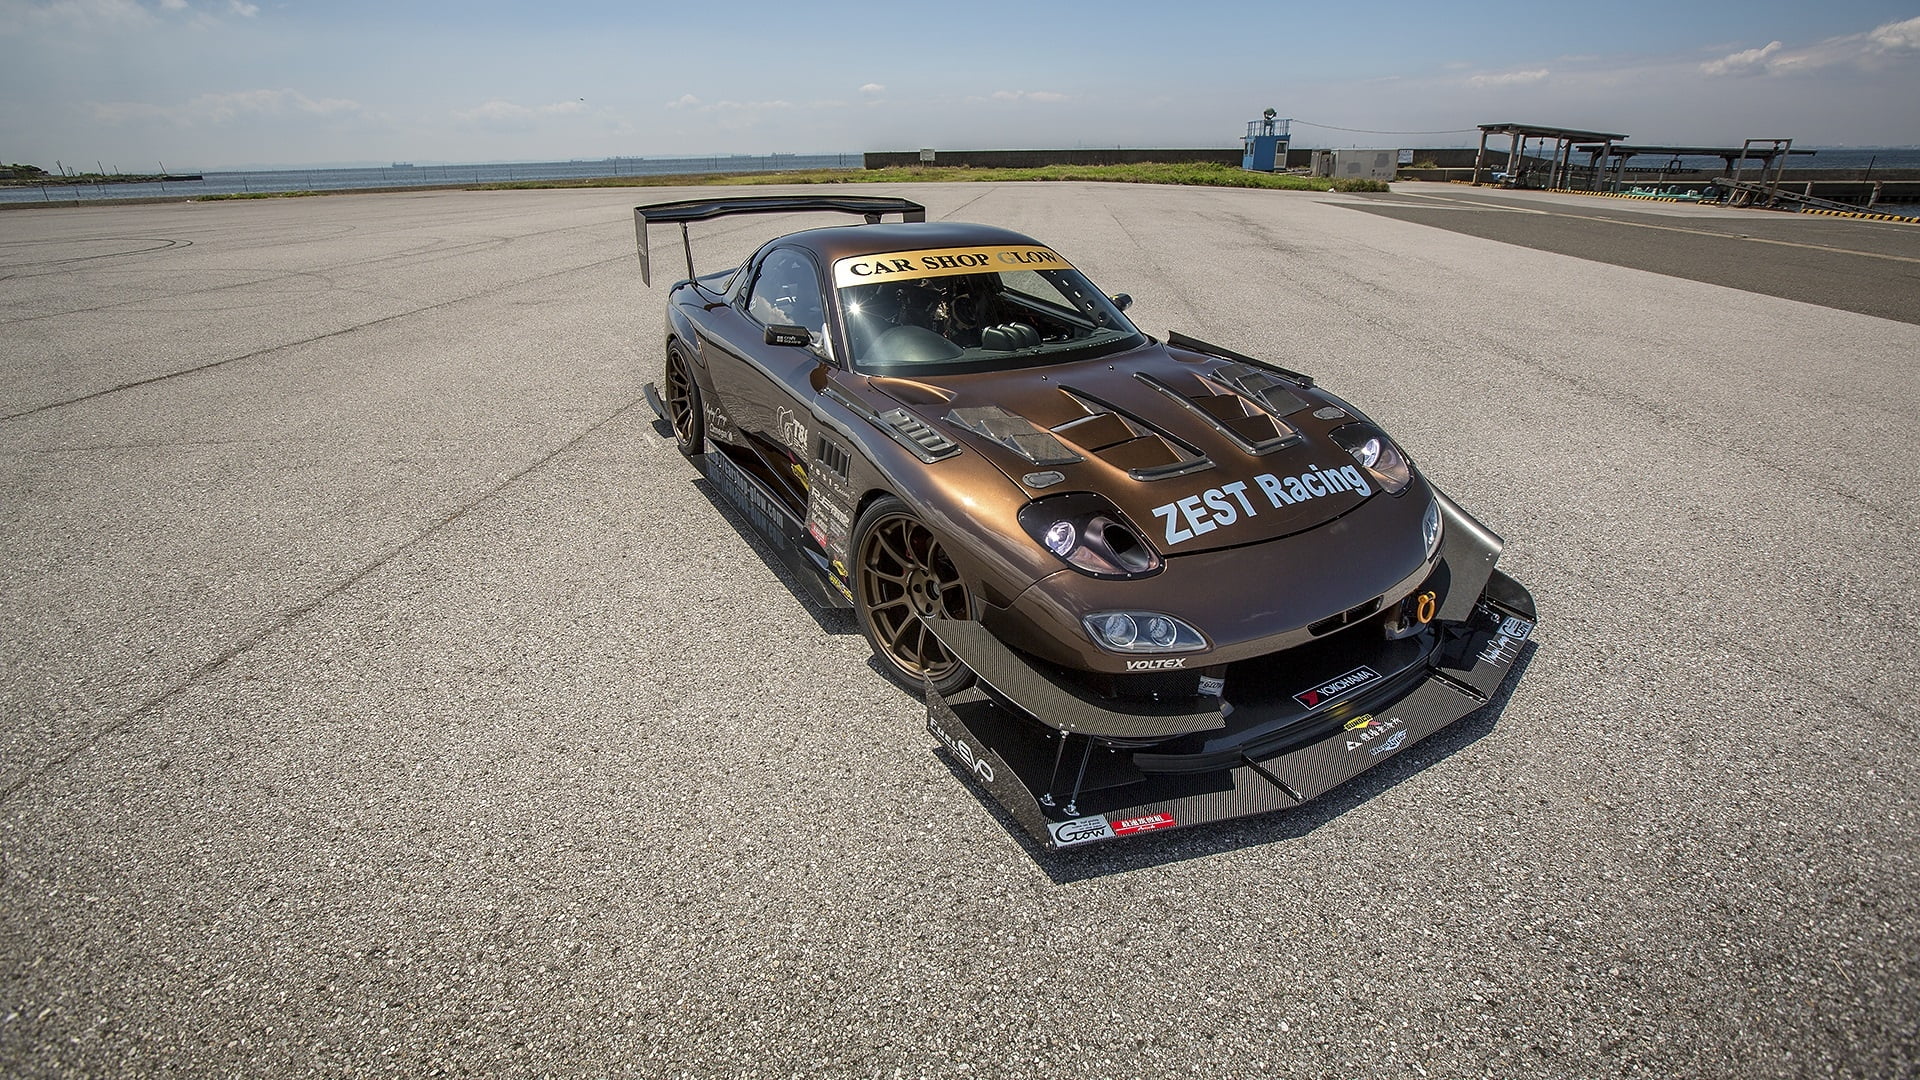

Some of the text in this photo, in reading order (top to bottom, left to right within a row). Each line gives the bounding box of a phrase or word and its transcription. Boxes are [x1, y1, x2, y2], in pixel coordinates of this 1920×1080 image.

[850, 250, 1059, 276] CAR SHOP GLOW
[1151, 463, 1372, 546] ZEST Racing
[1126, 657, 1187, 671] VOLTEX
[1316, 670, 1374, 697] YOKOHAMA
[1344, 714, 1372, 730] SUNOCO
